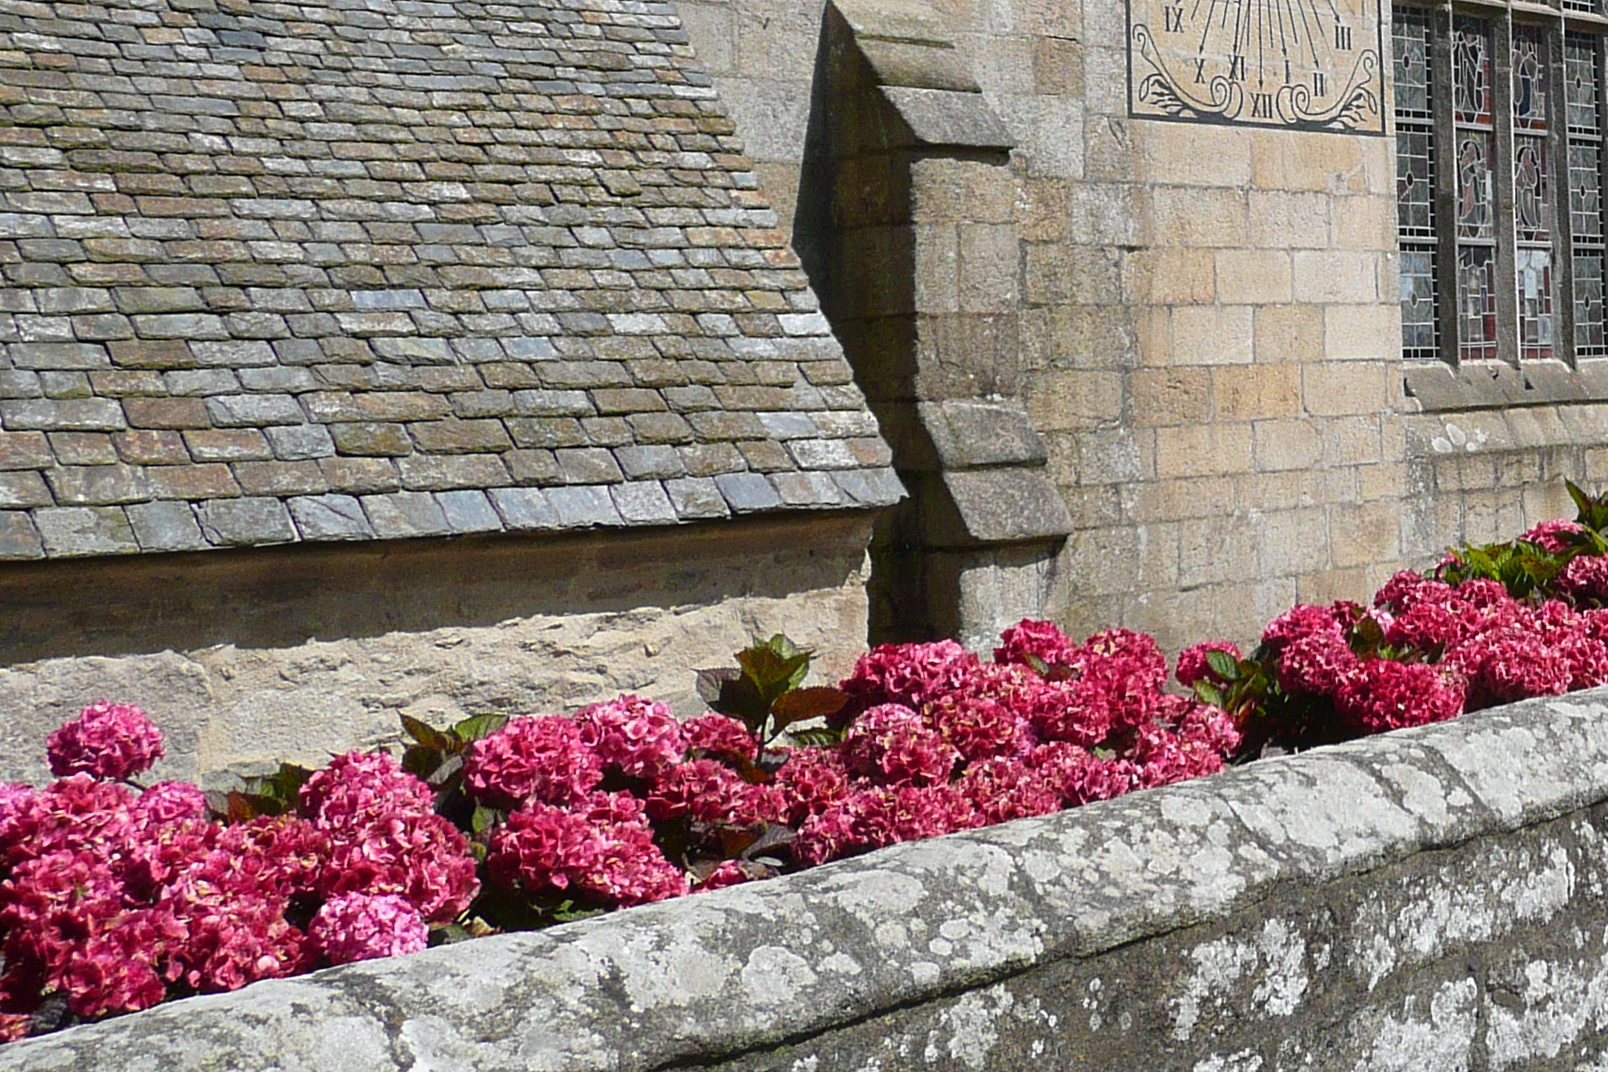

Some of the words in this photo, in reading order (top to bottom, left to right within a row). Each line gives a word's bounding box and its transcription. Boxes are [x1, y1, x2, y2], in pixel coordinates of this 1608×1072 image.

[1164, 5, 1185, 33] IX
[1334, 25, 1352, 51] III
[1193, 57, 1206, 84] X
[1227, 53, 1246, 82] XI
[1312, 72, 1325, 98] II
[1250, 91, 1274, 119] XII
